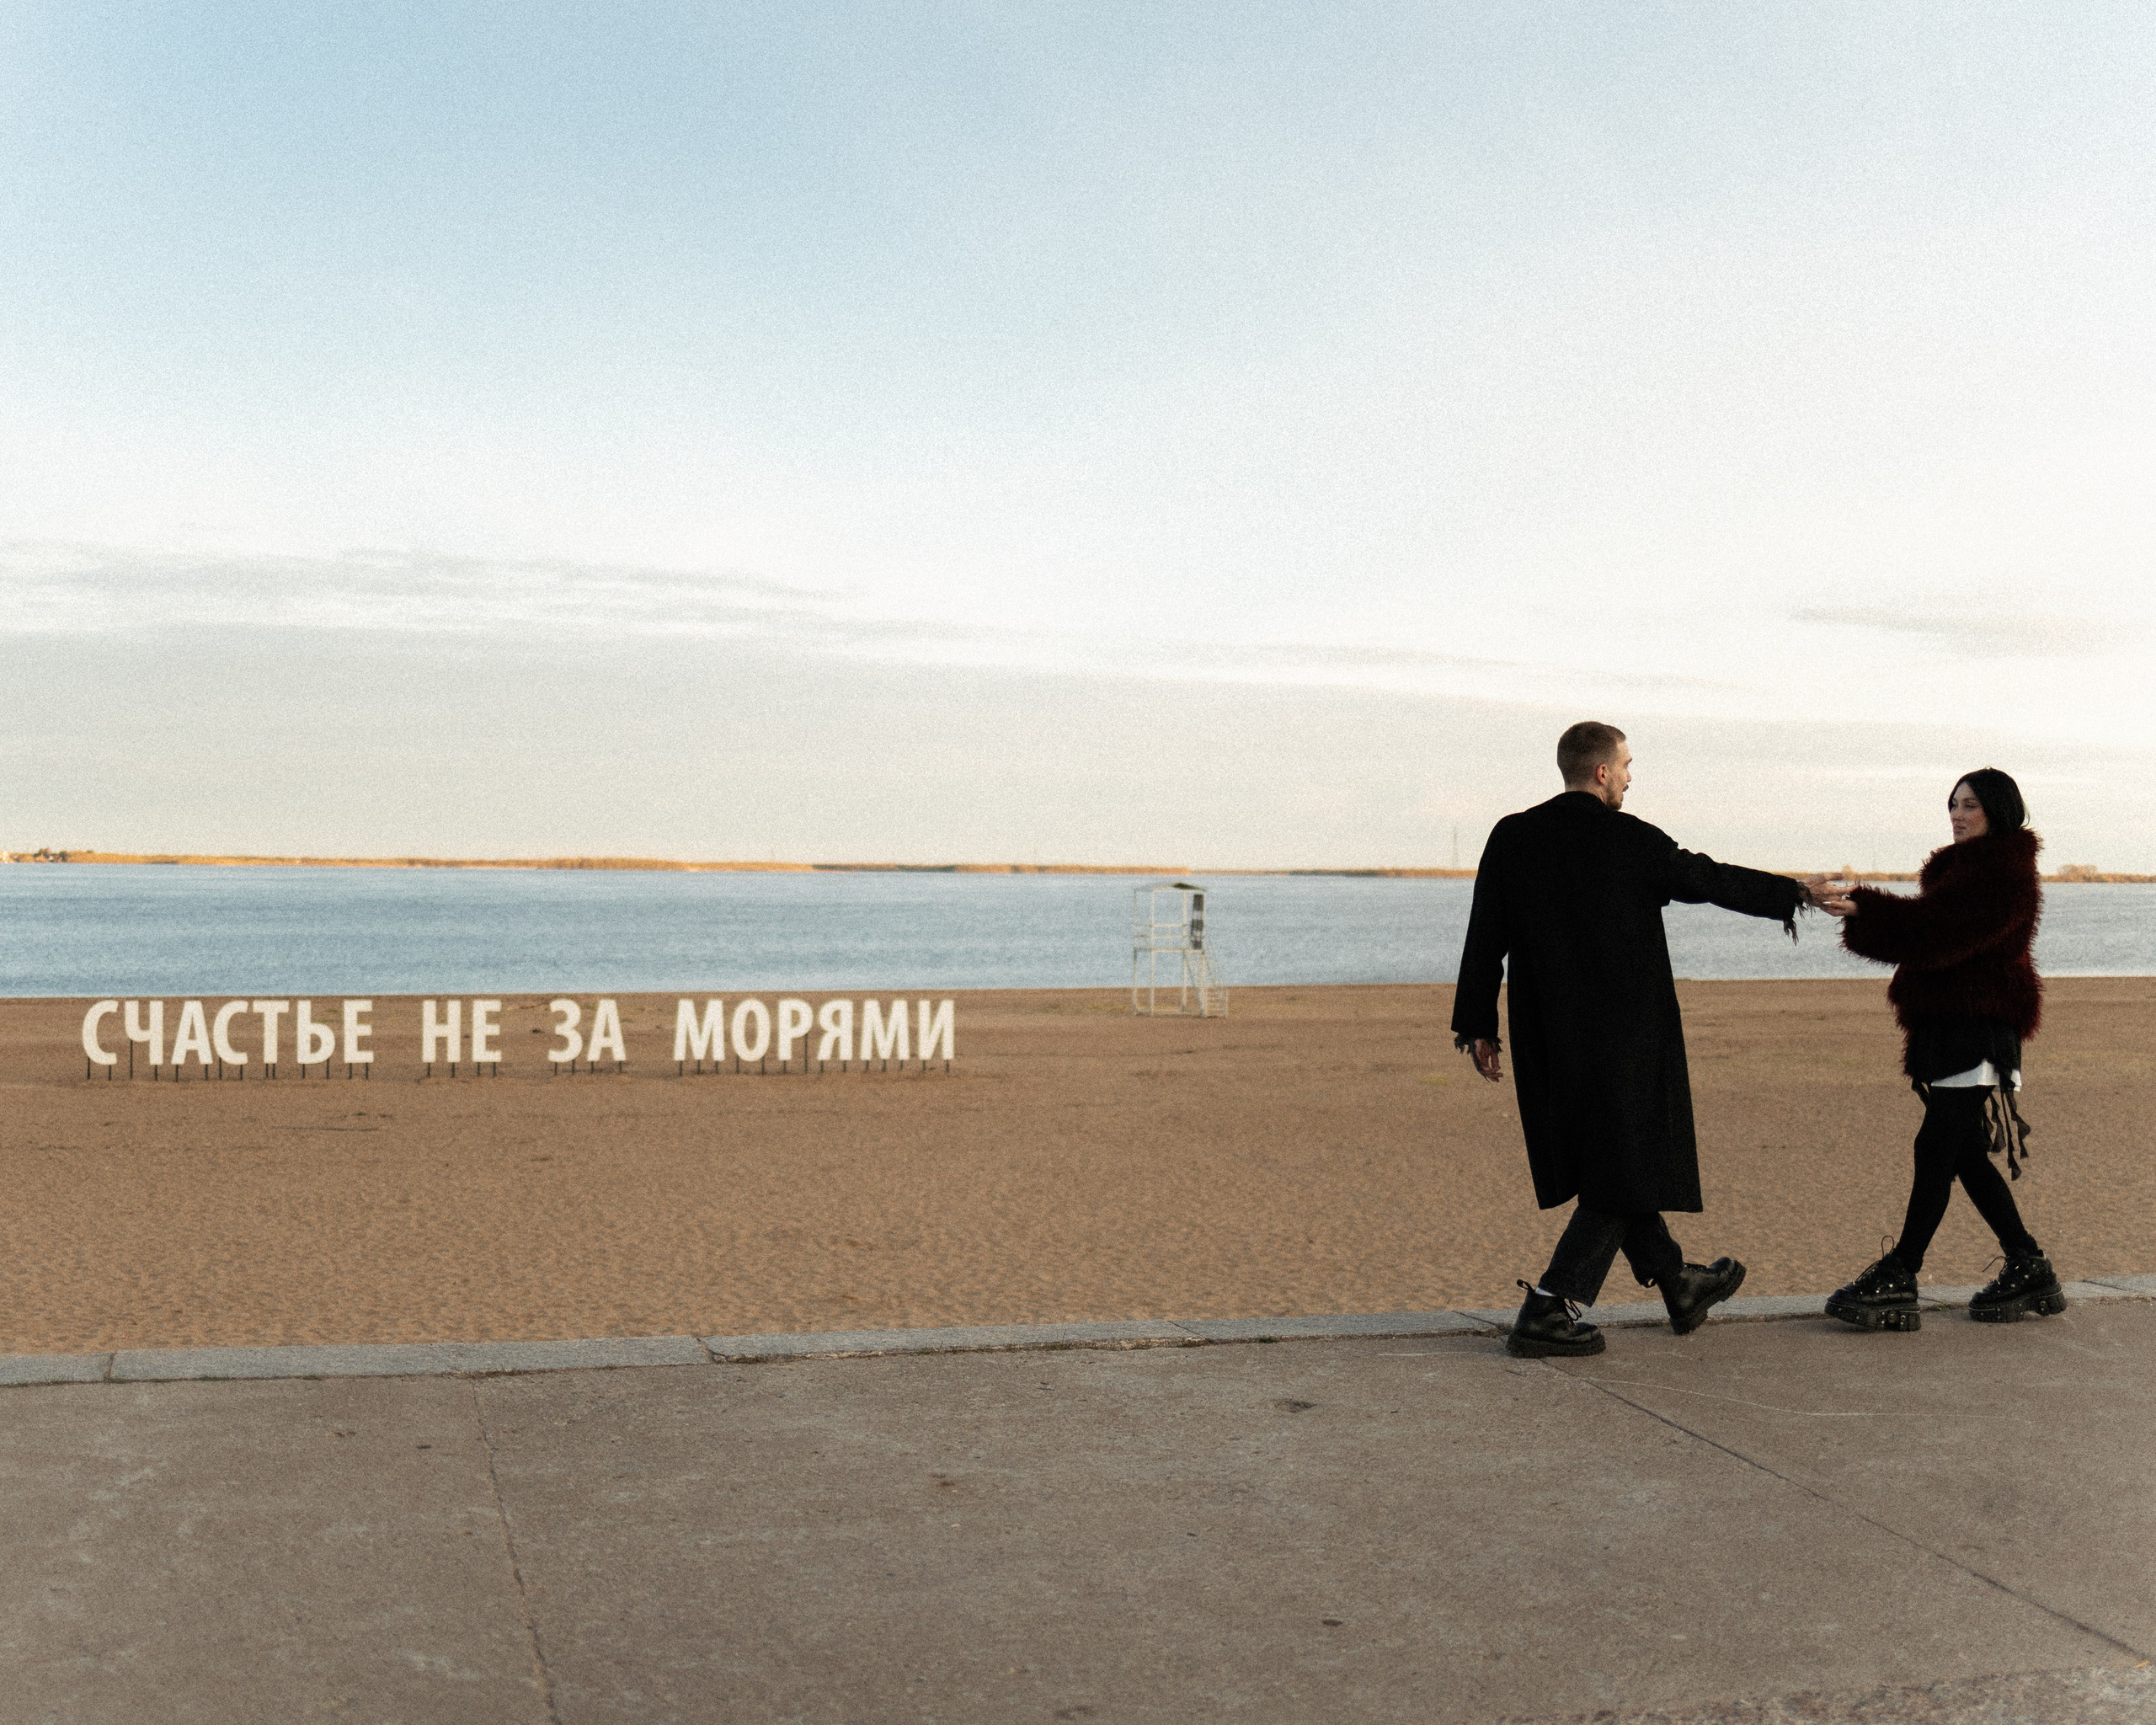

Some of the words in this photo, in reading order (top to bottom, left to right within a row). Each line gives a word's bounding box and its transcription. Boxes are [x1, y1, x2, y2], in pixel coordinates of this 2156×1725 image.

[82, 999, 375, 1065] СЧАСТЬЕ
[422, 999, 503, 1063] НЕ
[547, 998, 627, 1062] ЗА
[673, 998, 956, 1062] МОРЯМИ
